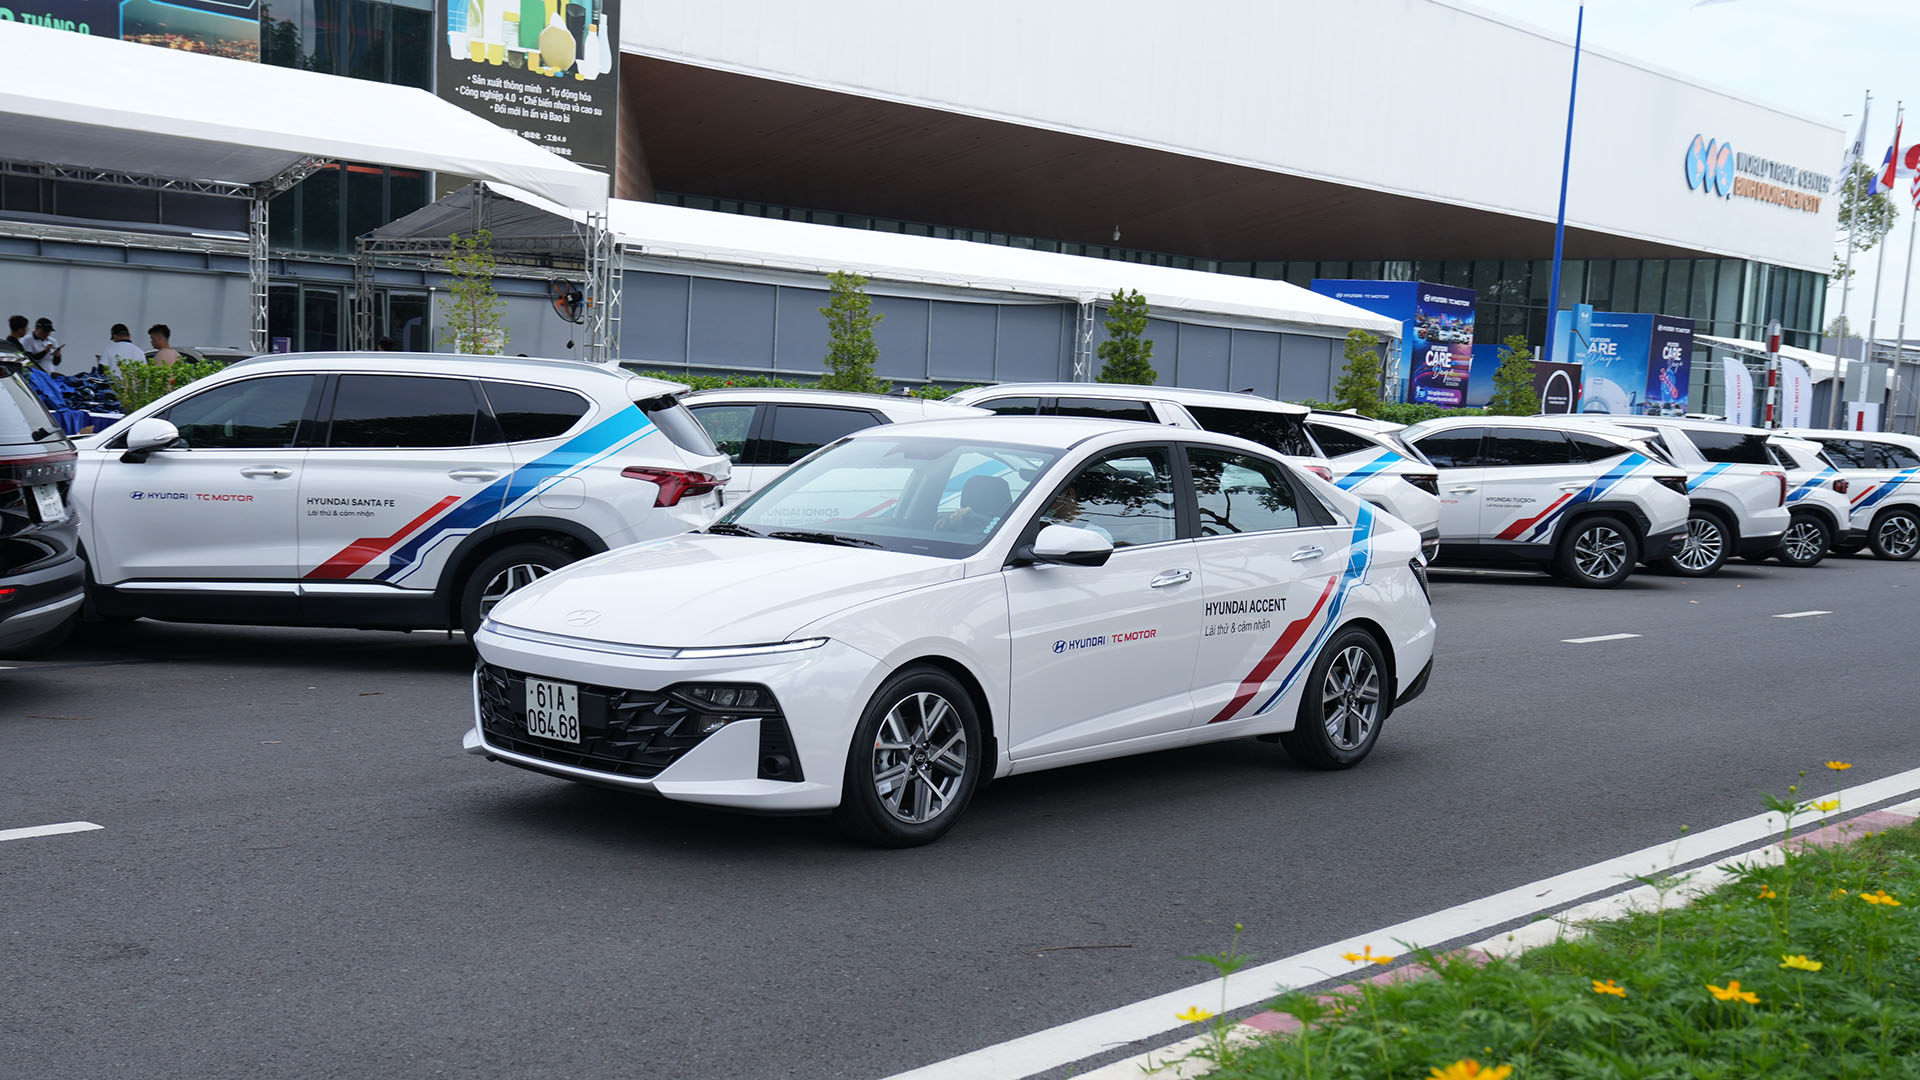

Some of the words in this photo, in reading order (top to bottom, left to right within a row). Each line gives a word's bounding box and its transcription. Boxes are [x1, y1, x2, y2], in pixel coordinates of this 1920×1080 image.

[471, 74, 486, 85] Sản
[487, 78, 502, 88] xuất
[503, 80, 523, 93] thông
[524, 84, 542, 94] minh
[550, 86, 561, 98] Tự
[561, 89, 578, 101] động
[579, 91, 592, 102] hóa
[460, 85, 479, 99] Công
[480, 90, 504, 102] nghiệp
[505, 93, 517, 103] 4.0
[523, 95, 538, 105] Chế
[538, 97, 553, 108] biến
[572, 103, 580, 112] và
[581, 106, 593, 114] cao
[594, 108, 603, 116] su
[540, 110, 548, 120] và
[549, 111, 563, 122] Bao
[1737, 152, 1768, 176] WORLD
[1769, 161, 1798, 185] TRADE
[1798, 169, 1832, 193] CENTER
[1803, 194, 1823, 213] CITY
[1587, 342, 1618, 356] ARE
[1662, 346, 1682, 361] CARE
[1425, 350, 1452, 368] CARE
[147, 492, 189, 500] HYUNDAI
[196, 493, 211, 501] TC
[211, 494, 254, 502] MOTOR
[306, 497, 350, 506] HYUNDAI
[351, 498, 382, 507] SANTA
[384, 499, 396, 507] FE
[1205, 600, 1248, 616] HYUNDAI
[1248, 597, 1287, 613] ACCENT
[1204, 624, 1216, 637] Lái
[1217, 622, 1230, 636] thử
[1230, 622, 1236, 634] &
[1237, 620, 1252, 633] cảm
[1253, 618, 1271, 632] nhận
[1068, 635, 1106, 650] HYUNDAI
[1111, 633, 1124, 643] TC
[1124, 629, 1157, 642] MOTOR
[536, 682, 566, 712] 61A
[528, 708, 578, 740] 064.68
